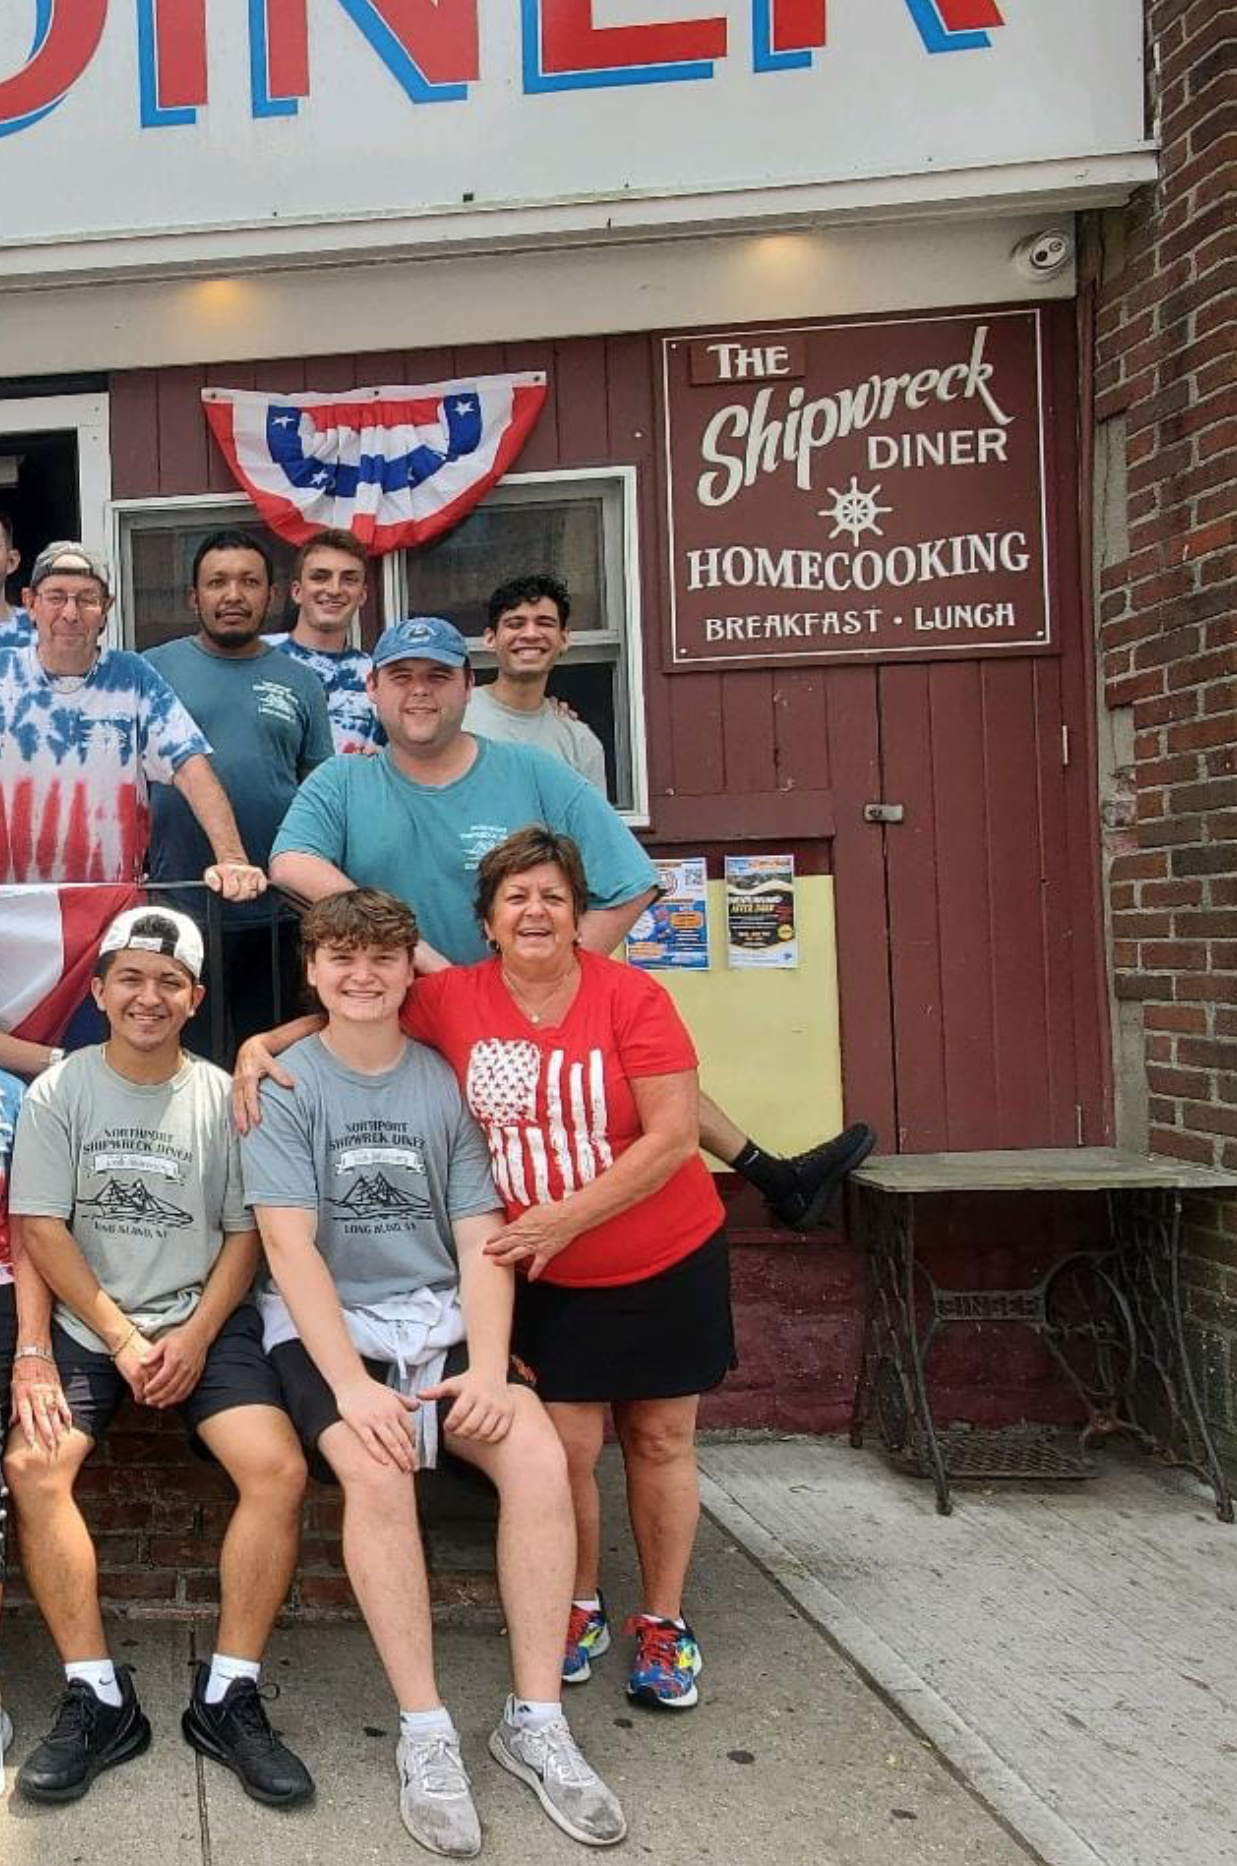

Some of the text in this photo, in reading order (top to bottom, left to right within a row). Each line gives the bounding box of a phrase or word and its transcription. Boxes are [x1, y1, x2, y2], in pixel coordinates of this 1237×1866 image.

[707, 343, 791, 379] THE
[697, 326, 1015, 506] Shipwreck
[867, 428, 1008, 471] DINER
[687, 531, 1031, 591] HOMECOOKING
[705, 605, 883, 641] BREAKFAST
